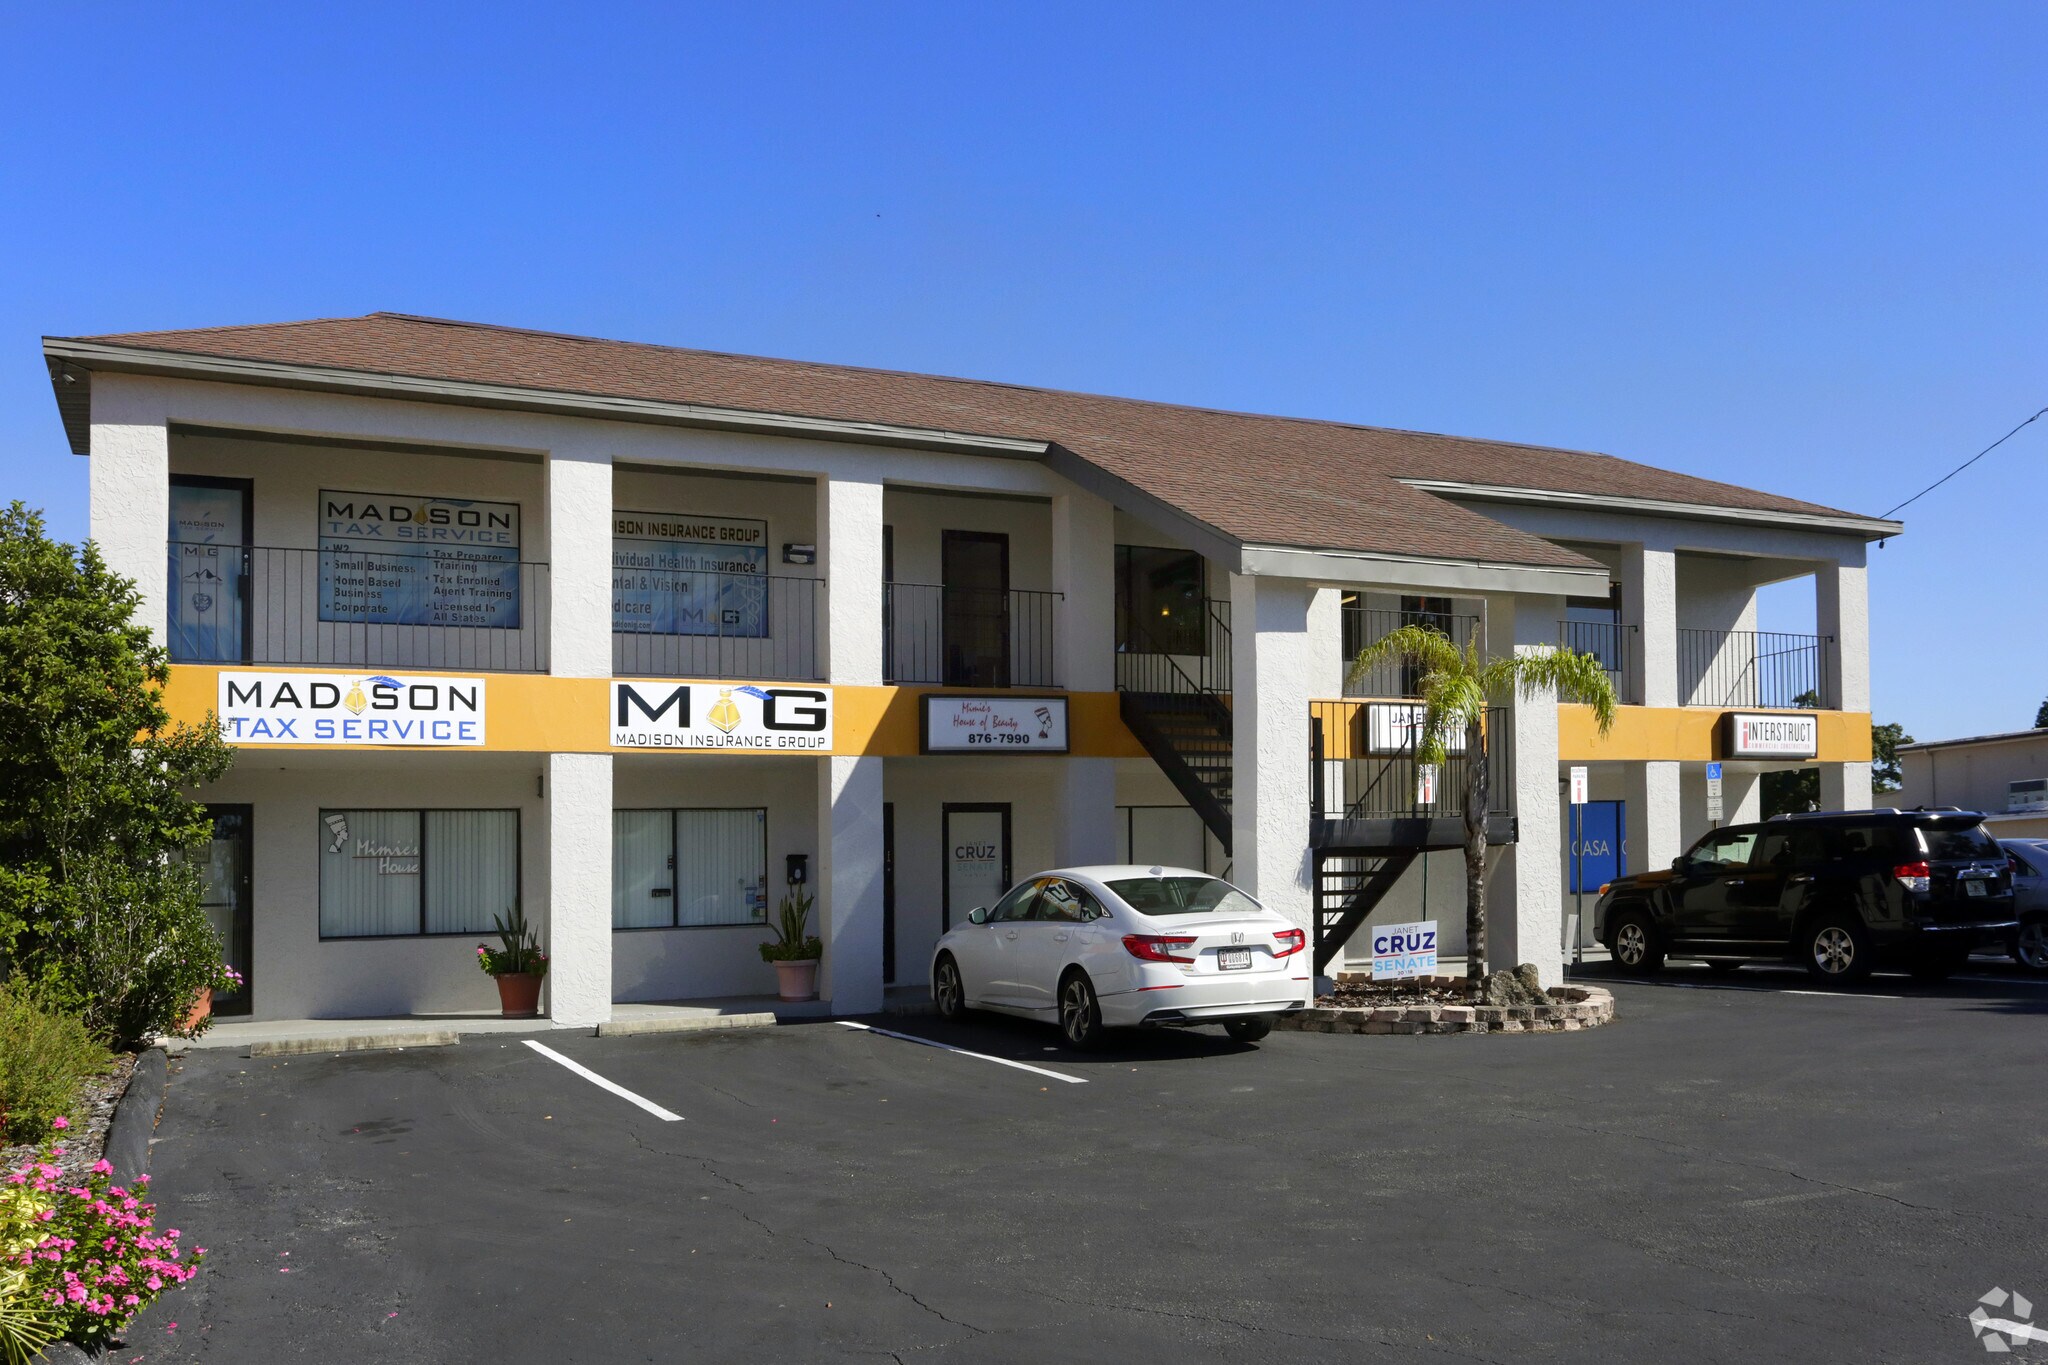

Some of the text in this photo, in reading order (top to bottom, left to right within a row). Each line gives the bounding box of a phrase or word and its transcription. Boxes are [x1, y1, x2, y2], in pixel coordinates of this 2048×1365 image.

[328, 521, 510, 543] TAX SERVICE
[648, 521, 716, 540] INSURANCE
[720, 526, 760, 542] GROUP
[433, 549, 503, 561] Tax Preparer
[333, 560, 416, 573] Small Business
[433, 561, 477, 573] Training
[659, 555, 696, 571] Health
[700, 559, 757, 573] Insurance
[334, 575, 401, 588] Home Based
[433, 574, 500, 586] Tax Enrolled
[640, 576, 648, 590] &
[652, 577, 688, 593] Vision
[335, 587, 382, 599] Business
[433, 586, 512, 600] Agent Training
[334, 602, 388, 615] Corporate
[433, 602, 495, 612] Licensed In
[433, 613, 486, 622] All States
[953, 714, 1018, 731] House of Beauty
[1392, 712, 1426, 724] JANE
[228, 717, 477, 740] TAX SERVICE
[1749, 722, 1811, 742] INTERSTRUCT
[616, 733, 826, 748] MADISON INSURANCE GROUP
[968, 733, 1030, 744] 876-7990
[955, 846, 996, 859] CRUZ
[1572, 840, 1610, 856] CASA
[379, 857, 418, 874] House
[1392, 926, 1419, 935] JANET
[1374, 931, 1436, 954] CRUZ
[1375, 956, 1436, 972] SENATE
